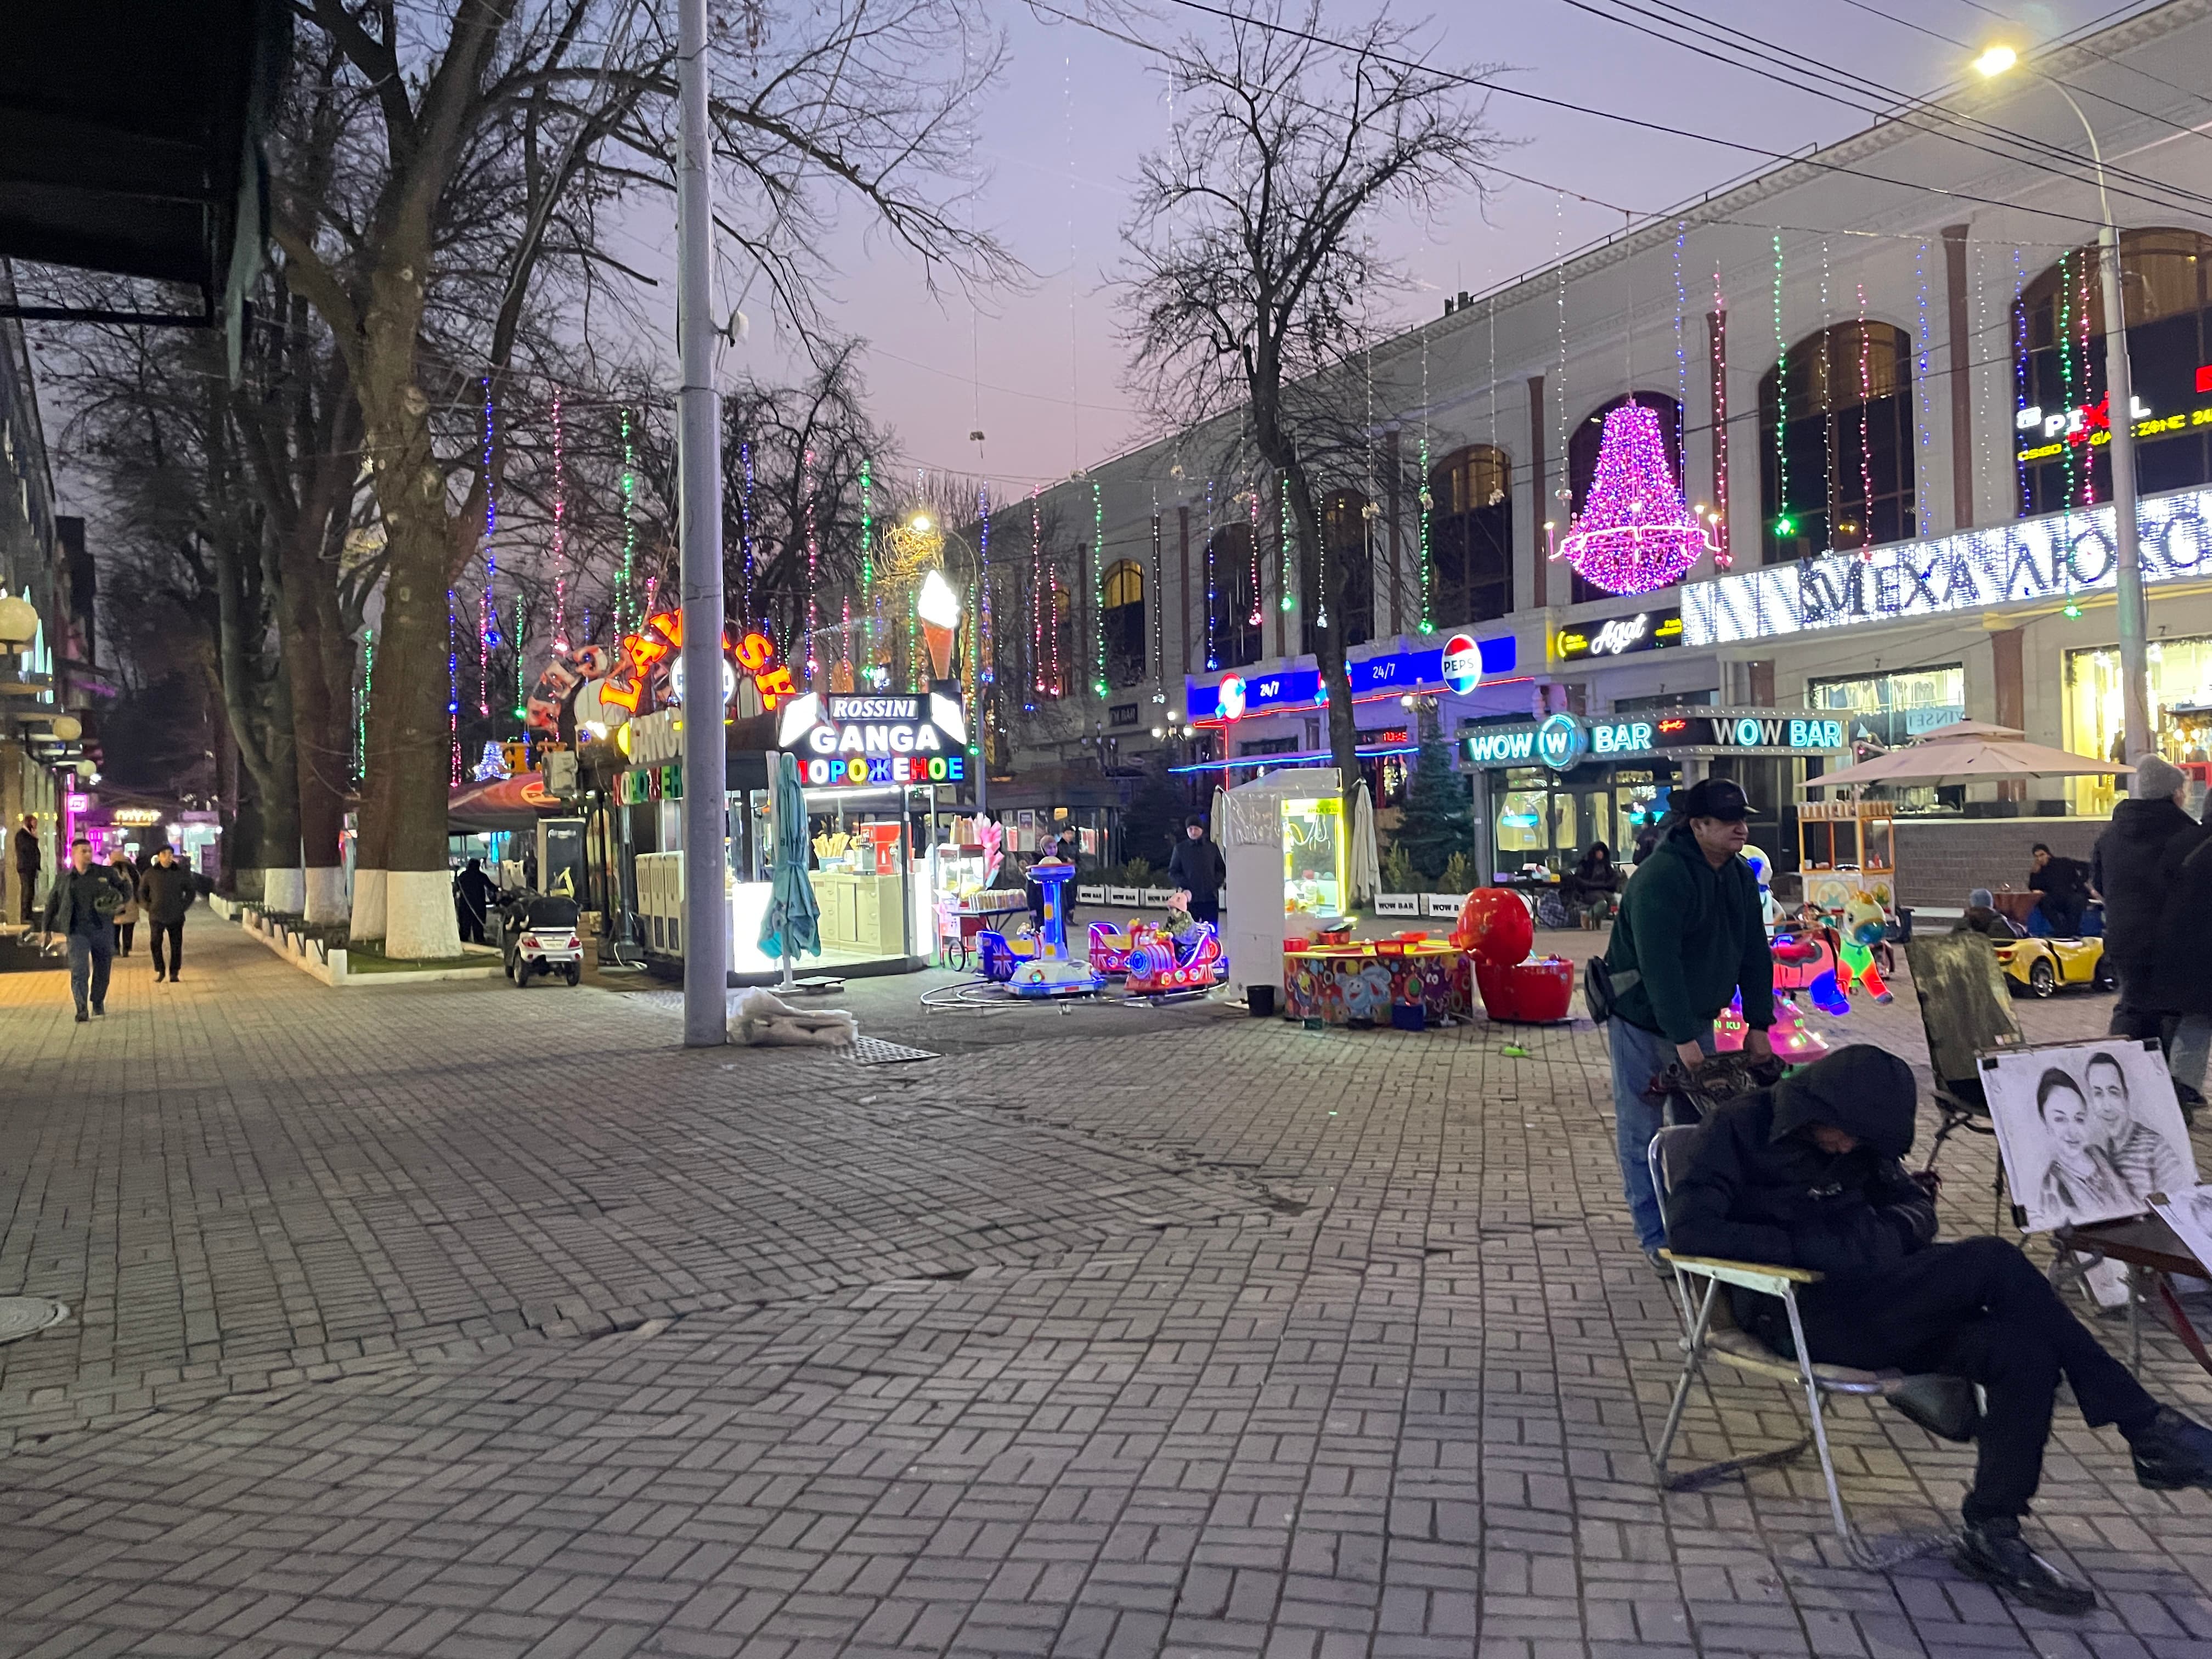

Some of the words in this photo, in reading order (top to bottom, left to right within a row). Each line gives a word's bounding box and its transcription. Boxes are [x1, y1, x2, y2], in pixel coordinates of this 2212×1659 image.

[2045, 395, 2152, 438] PIXL
[2137, 414, 2186, 437] ZONE
[600, 608, 797, 713] LAVSH
[1373, 663, 1396, 679] 24/7
[1444, 658, 1474, 673] PEPS
[1260, 681, 1279, 697] 24/7
[833, 700, 916, 718] ROSSINI
[810, 725, 941, 754] GANGA
[1470, 732, 1534, 761] WOW
[1594, 722, 1653, 753] BAR
[1712, 718, 1784, 746] WOW
[1790, 720, 1840, 748] BAR
[612, 764, 684, 808] МОРОЖЕН
